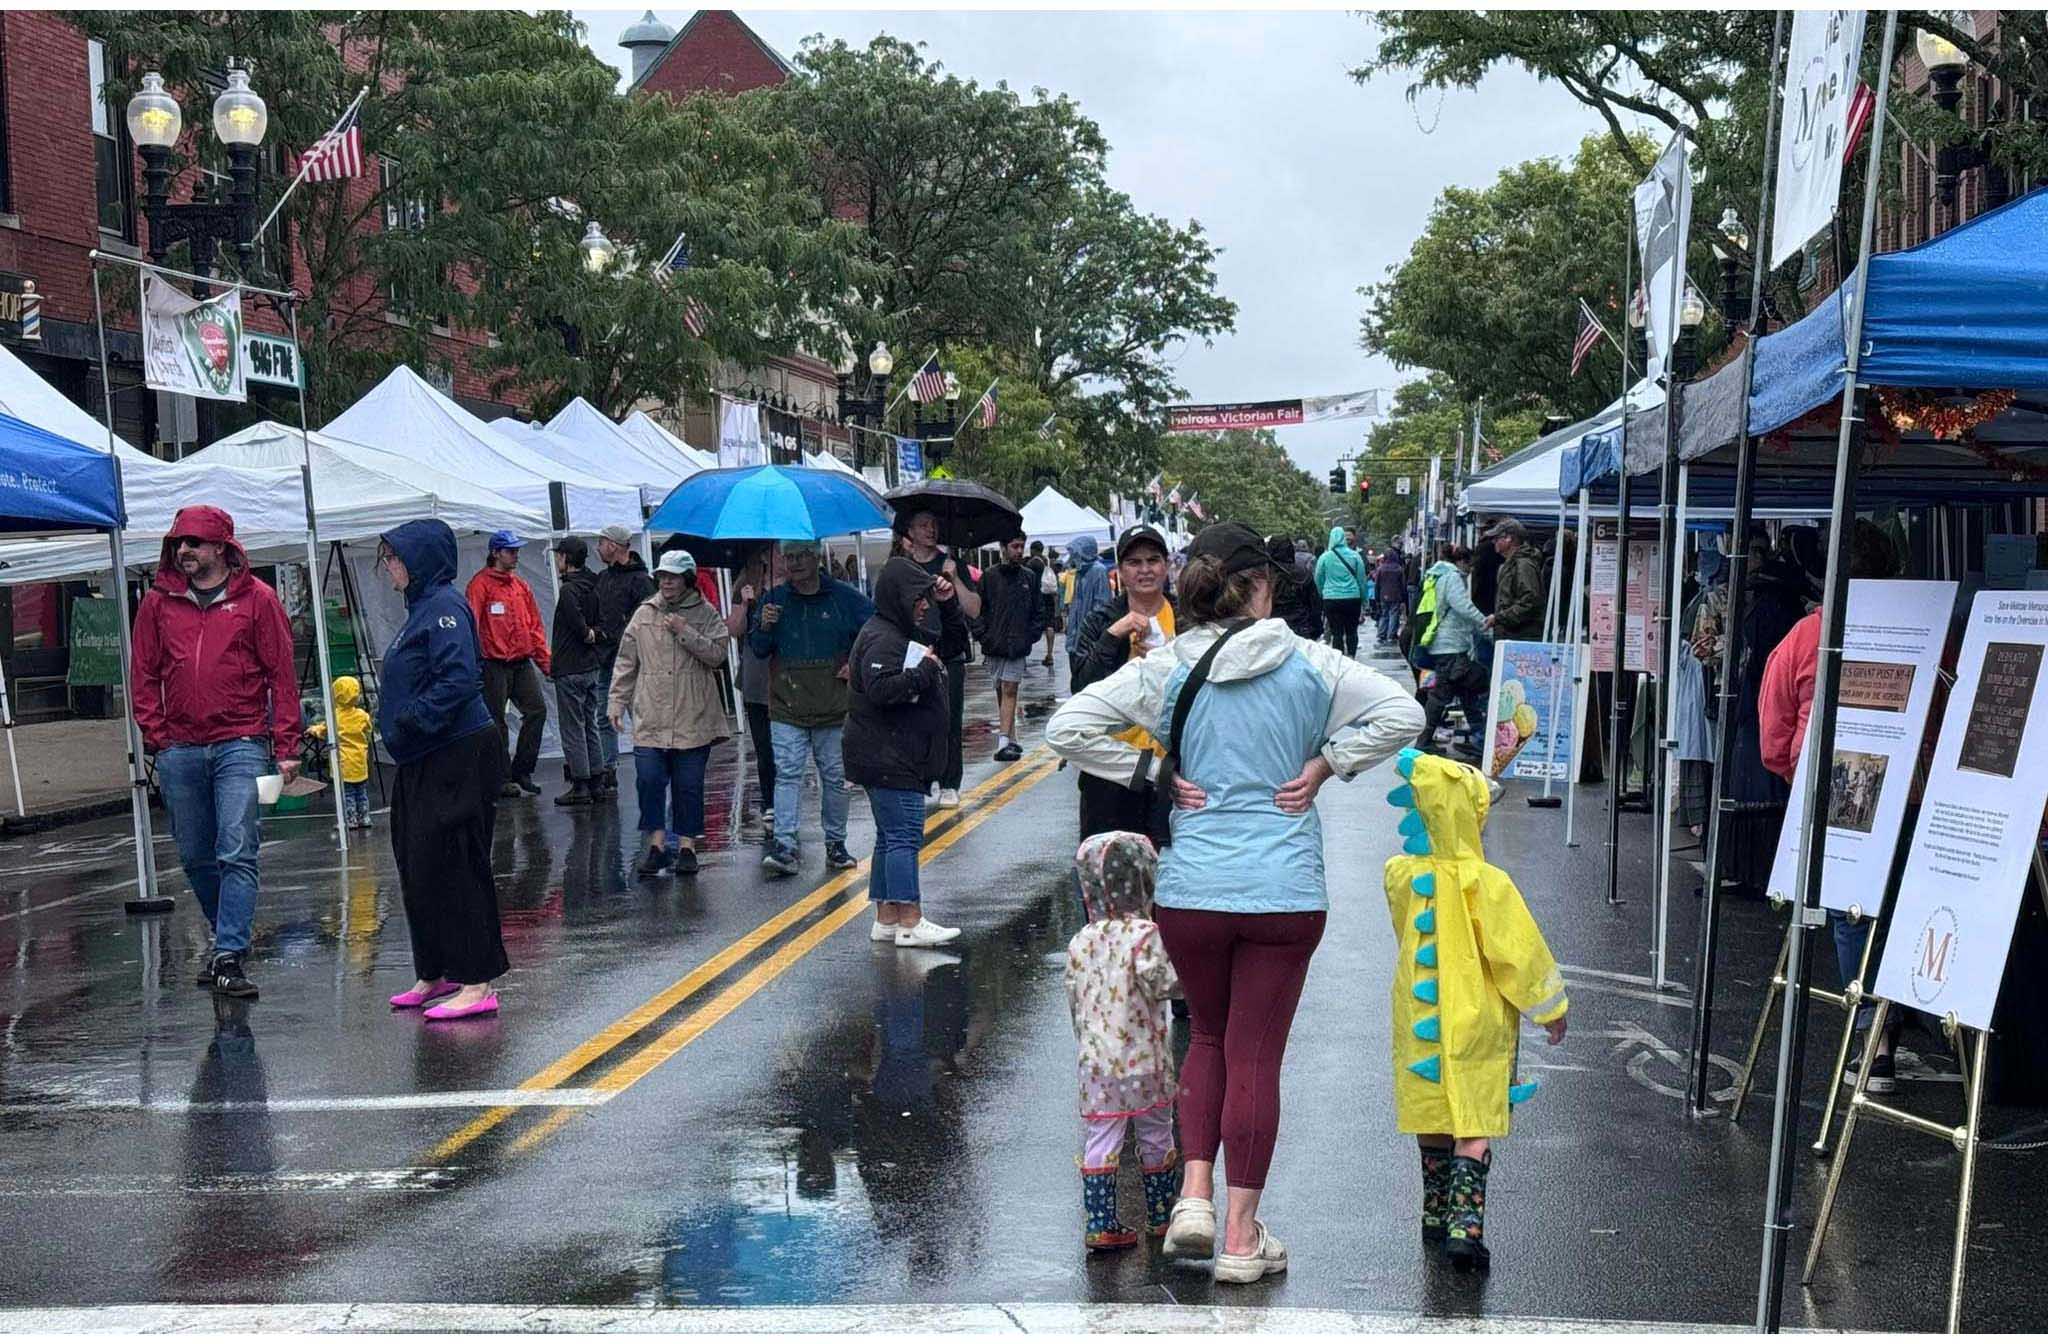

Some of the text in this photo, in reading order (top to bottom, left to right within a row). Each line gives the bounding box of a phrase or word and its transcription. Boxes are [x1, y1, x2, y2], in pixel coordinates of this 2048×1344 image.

[1219, 409, 1275, 424] Victorian
[1277, 407, 1301, 420] Fair
[21, 472, 60, 494] Protect
[1916, 927, 1953, 982] M
